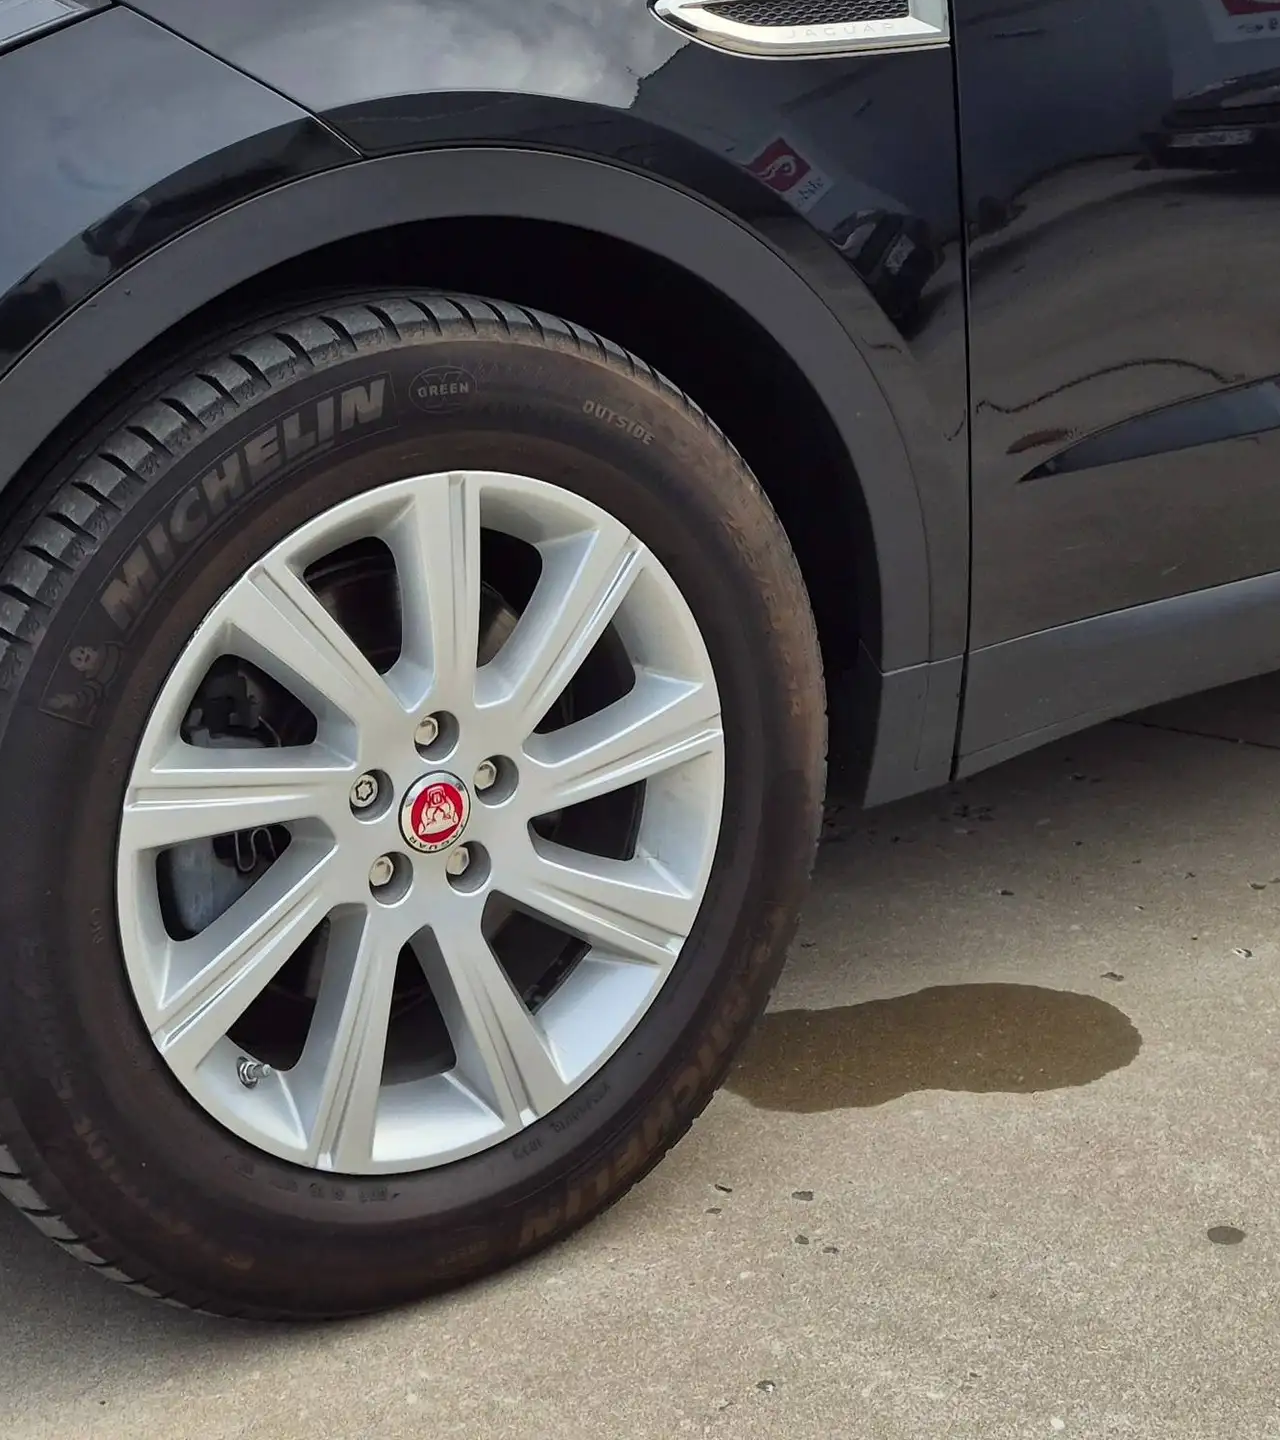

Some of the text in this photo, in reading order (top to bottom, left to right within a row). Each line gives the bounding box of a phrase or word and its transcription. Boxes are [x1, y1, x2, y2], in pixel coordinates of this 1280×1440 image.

[786, 21, 897, 40] JAGUAR
[415, 380, 470, 399] GREEN
[582, 399, 656, 446] OUTSIDE
[98, 377, 387, 631] MICHELIN
